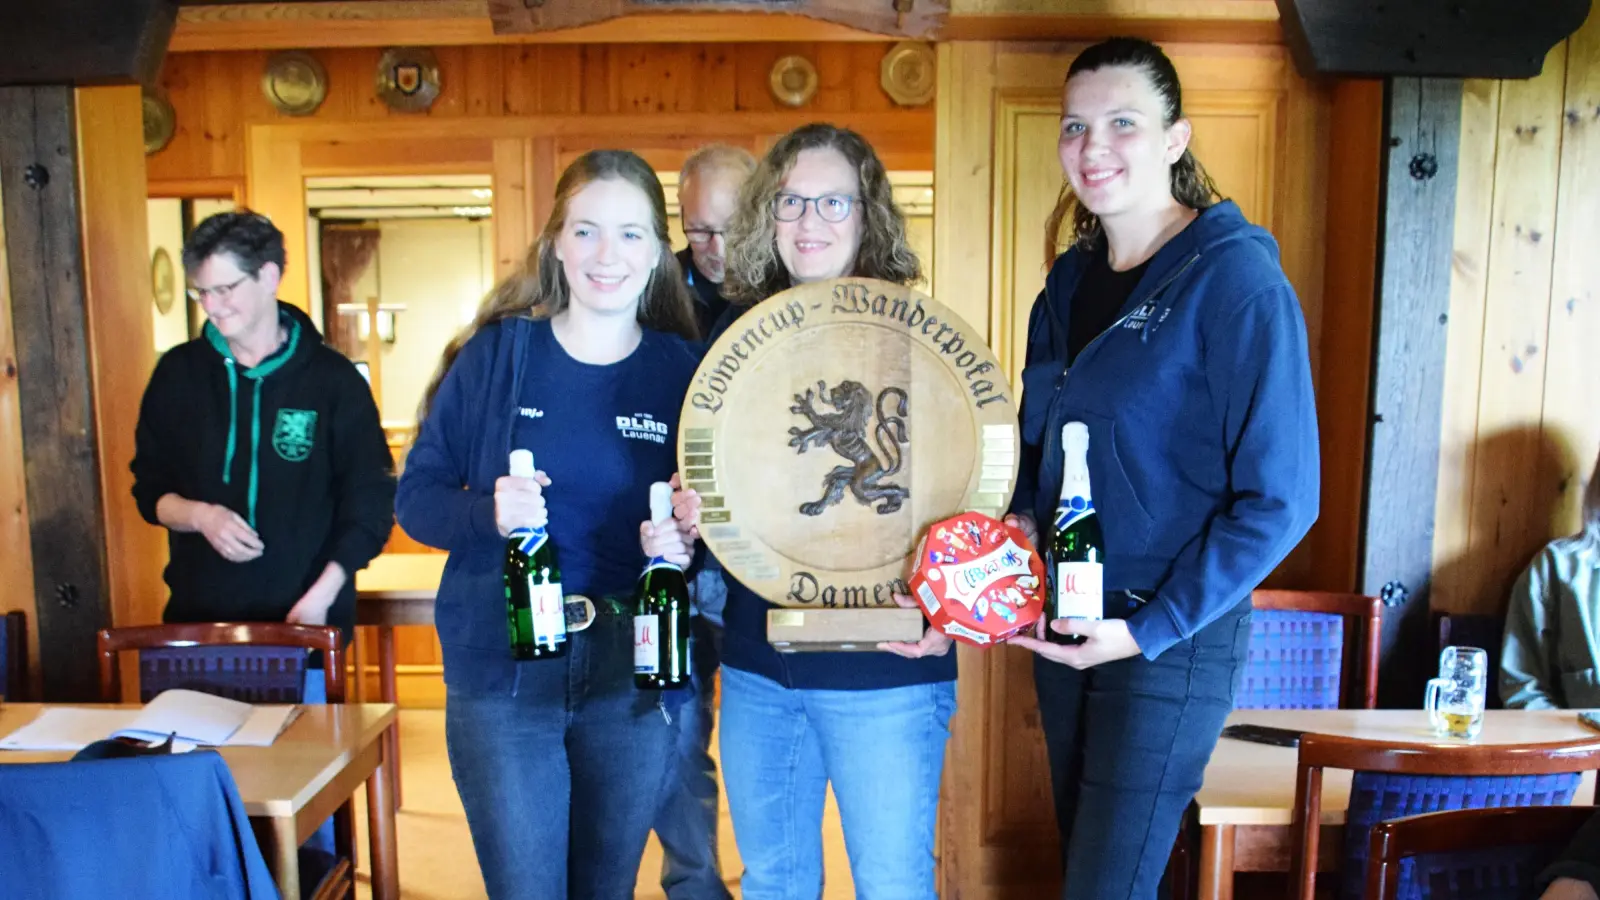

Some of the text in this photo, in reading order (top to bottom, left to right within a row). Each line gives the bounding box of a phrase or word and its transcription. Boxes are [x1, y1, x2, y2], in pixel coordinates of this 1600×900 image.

[691, 300, 805, 414] Löwencup
[831, 283, 1008, 409] Wanderpokal
[615, 415, 668, 435] DLRG
[622, 428, 666, 445] Lauenau
[786, 571, 907, 608] Damen
